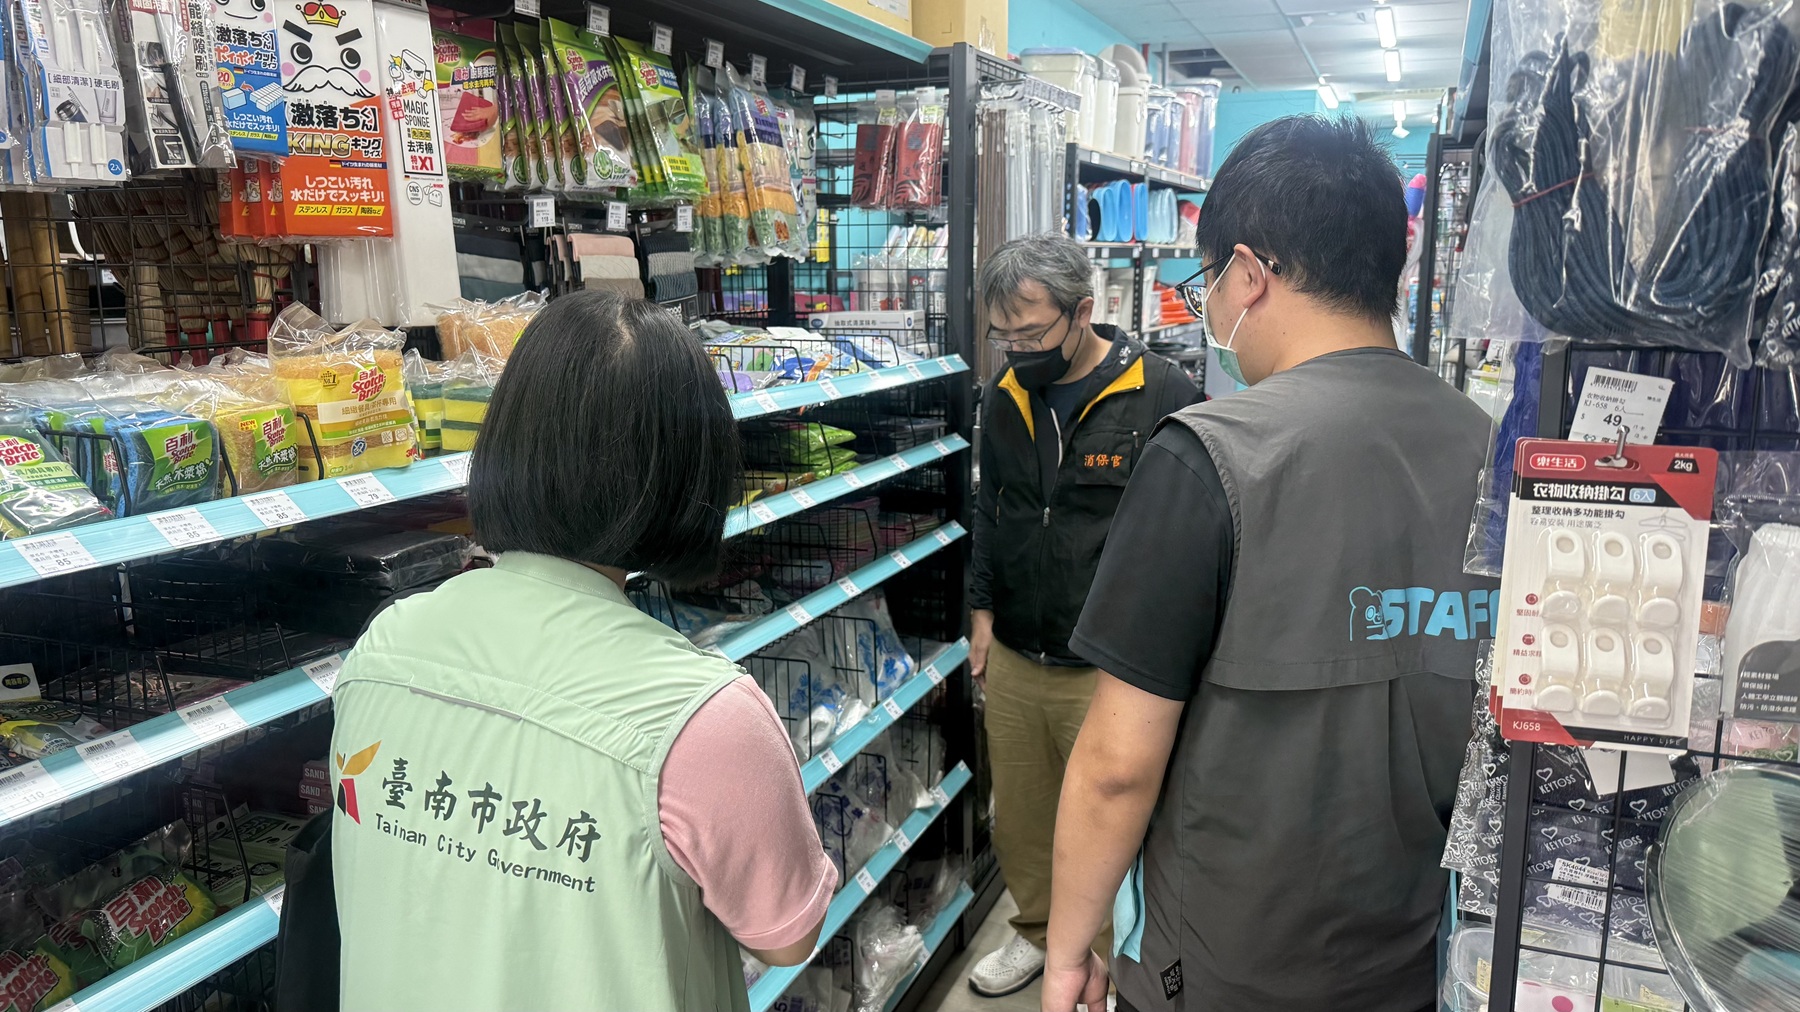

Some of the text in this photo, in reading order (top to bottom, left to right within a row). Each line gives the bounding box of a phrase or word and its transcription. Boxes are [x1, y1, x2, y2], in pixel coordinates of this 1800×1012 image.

[187, 0, 209, 72] 能縫隙刷
[94, 78, 120, 90] 硬毛刷
[218, 72, 230, 82] 20
[403, 99, 429, 115] MAGIC
[233, 112, 273, 123] しつこい汚れ
[405, 114, 430, 128] SPONGE
[288, 132, 351, 156] KING
[351, 137, 382, 149] キング
[364, 149, 381, 158] サイズ
[305, 175, 373, 190] しつこい汚れ
[409, 185, 420, 193] CNS
[290, 188, 385, 203] 水だけでスッキリ!
[360, 367, 378, 380] 百利
[358, 383, 384, 401] Brite
[240, 419, 256, 427] NEW
[1603, 413, 1622, 427] 49
[166, 430, 194, 453] 百利
[0, 443, 39, 458] cotch-
[5, 450, 41, 466] Brite
[1084, 453, 1122, 468] 消保官
[1536, 455, 1577, 469] 樂生活
[1674, 460, 1693, 472] 2kg
[368, 493, 379, 501] 79
[1533, 482, 1653, 502] 衣物收納掛勾 6入
[277, 512, 289, 520] 85
[1531, 505, 1625, 519] 整理收納多功能掛勾
[186, 530, 200, 539] 85
[55, 558, 71, 567] 85
[1516, 608, 1541, 617] 堅固耐
[1509, 687, 1534, 696] 簡約時
[216, 722, 229, 732] 22
[1512, 720, 1541, 732] KJ658
[1623, 734, 1681, 747] HAPPY LIFE
[304, 767, 325, 779] SAND
[300, 784, 320, 796] SAND
[1538, 774, 1700, 797] KEYTOSS KEYTOSS
[382, 757, 602, 863] 臺南市政府
[375, 813, 427, 846] Tainan
[437, 834, 477, 862] City
[1544, 833, 1643, 856] KEYTOSS KETOSS
[1466, 853, 1498, 868] KEYTOSS
[1527, 860, 1554, 876] YTOSS
[105, 876, 164, 929] 百利
[1611, 896, 1646, 912] KEYTOS
[127, 883, 188, 937] Scotch-
[147, 897, 191, 945] Brite
